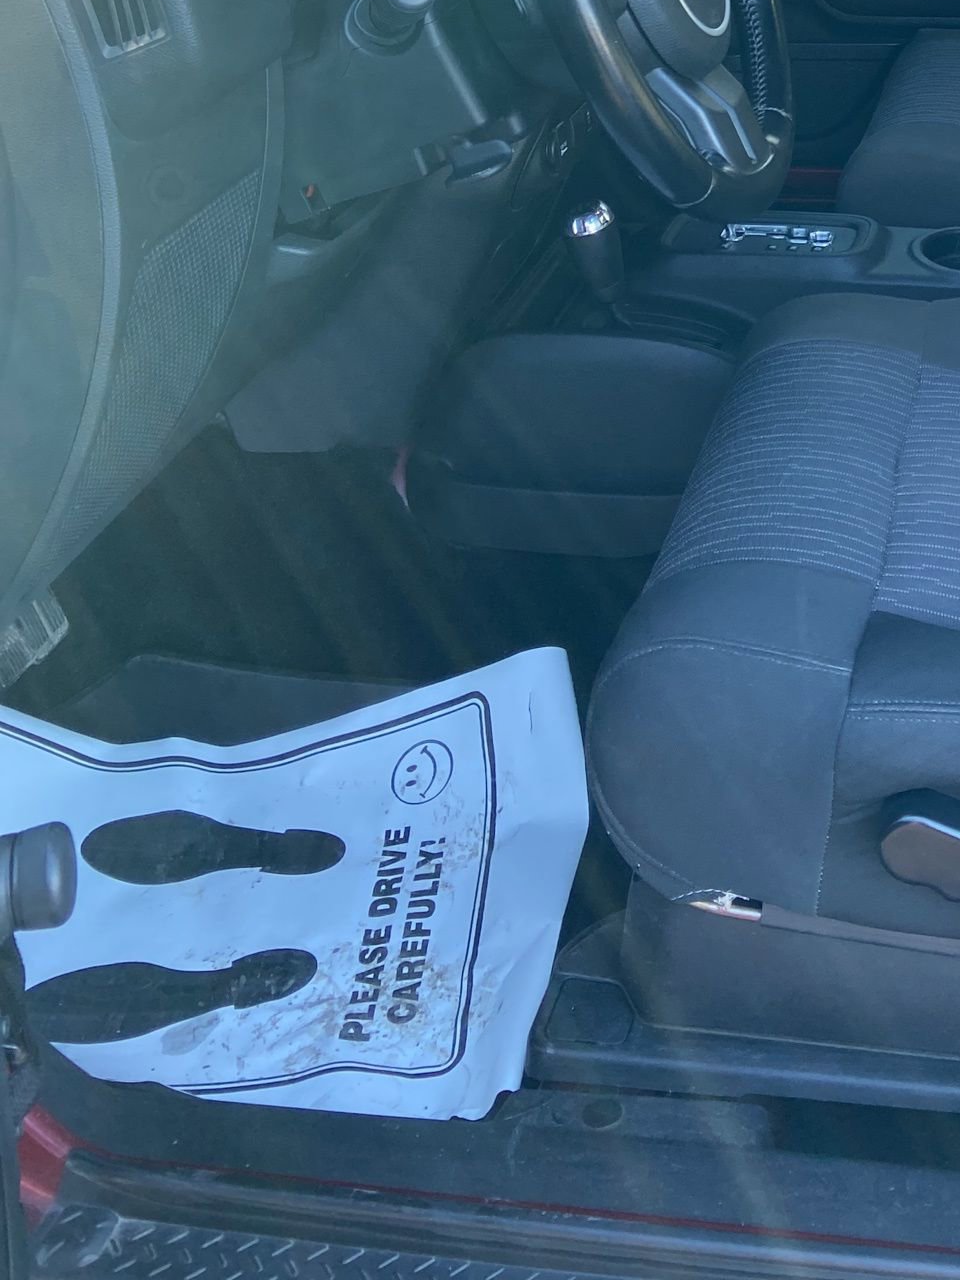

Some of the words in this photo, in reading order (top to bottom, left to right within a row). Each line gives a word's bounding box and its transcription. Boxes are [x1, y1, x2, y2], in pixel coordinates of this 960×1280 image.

[338, 925, 392, 1042] PLEASE
[368, 825, 411, 917] DRIVE
[386, 836, 446, 1025] CAREFULLY!
